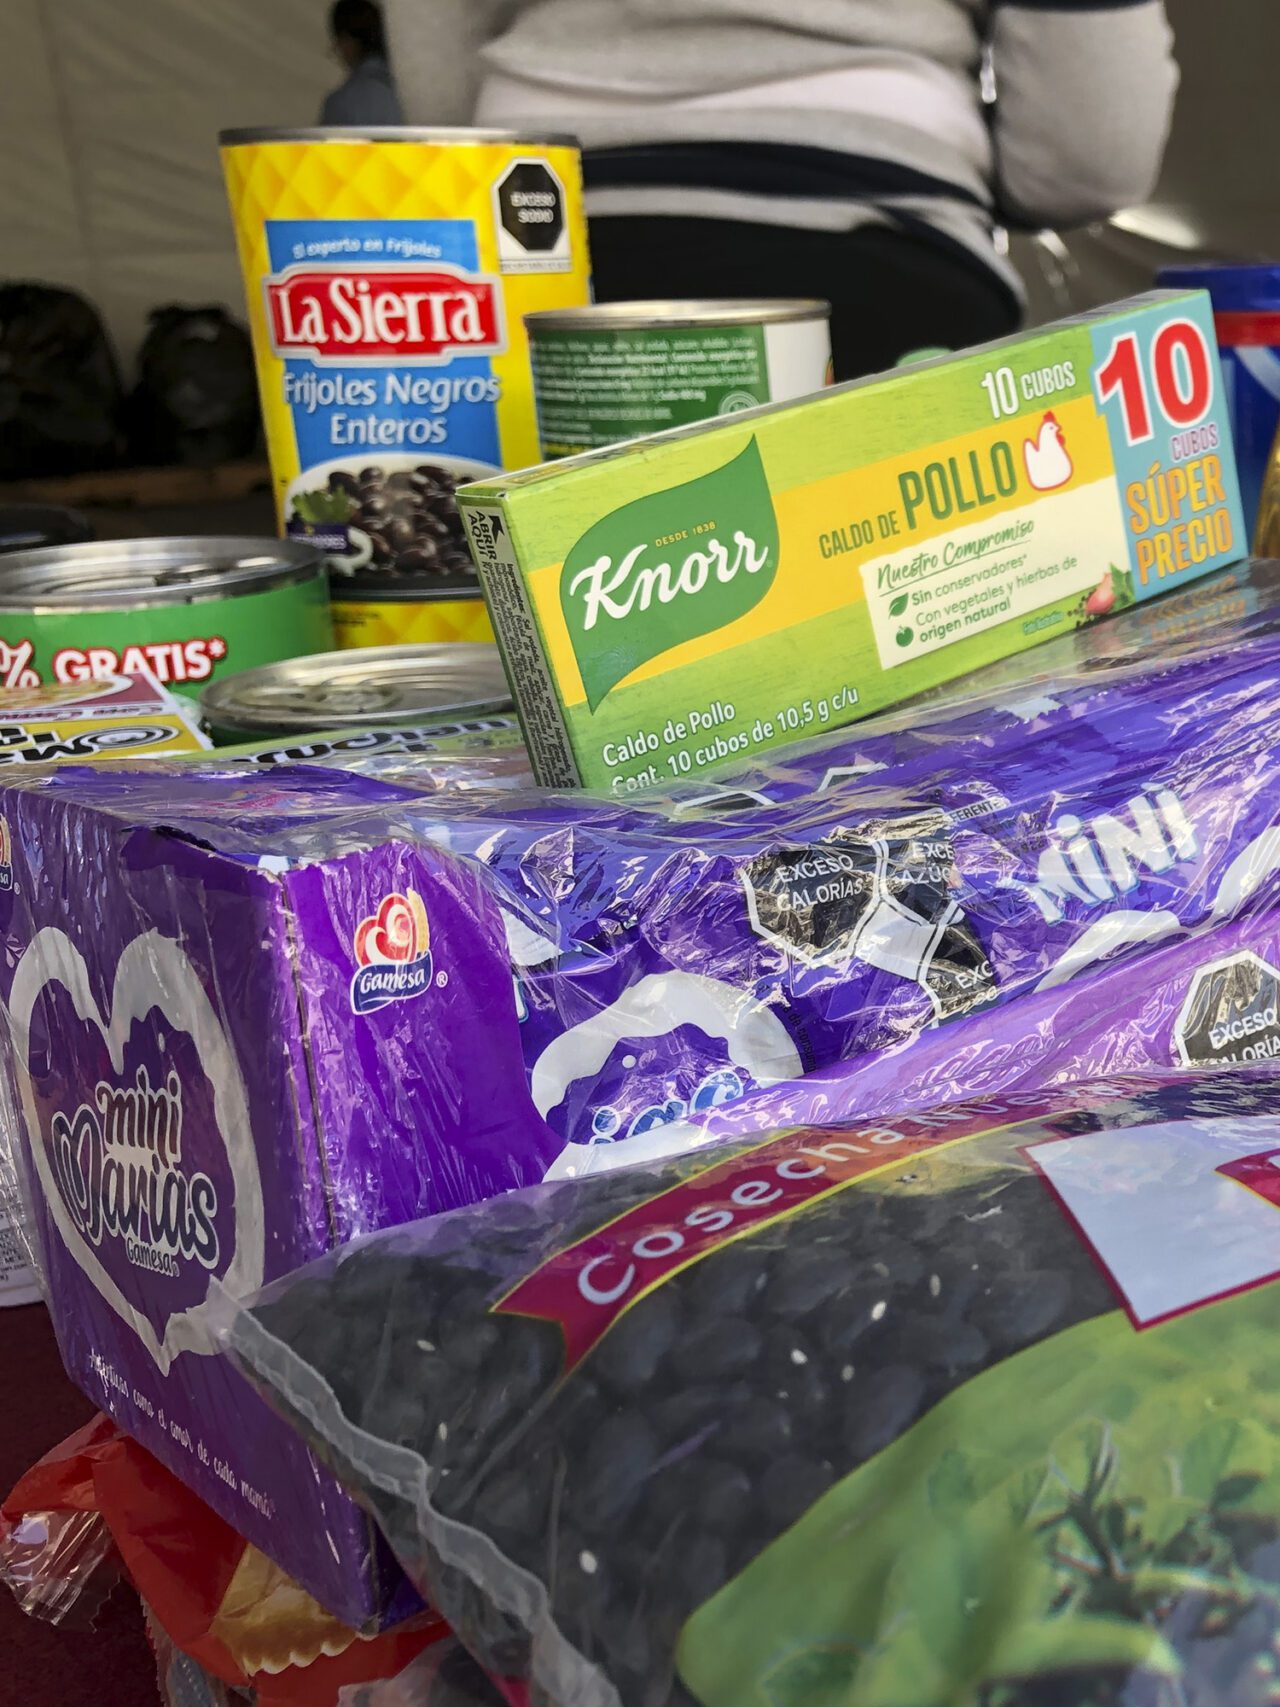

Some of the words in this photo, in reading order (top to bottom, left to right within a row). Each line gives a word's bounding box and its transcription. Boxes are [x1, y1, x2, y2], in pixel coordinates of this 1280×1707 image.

[276, 289, 328, 343] La
[329, 277, 485, 343] Sierra
[284, 372, 377, 413] Frijoles
[384, 373, 502, 414] Negros
[981, 366, 1020, 420] 10
[1020, 360, 1076, 401] CUBOS
[1094, 317, 1214, 448] 10
[330, 412, 448, 445] Enteros
[1171, 423, 1219, 463] CUBOS
[818, 518, 875, 560] CALDO
[876, 509, 900, 541] DE
[897, 440, 1018, 530] POLLO
[1126, 453, 1228, 535] SÚPER
[467, 513, 488, 557] AQUÍ
[476, 510, 498, 561] ABRIR
[654, 529, 689, 548] DESDE
[691, 521, 717, 537] 1838
[877, 549, 939, 591] Nuestro
[943, 519, 1035, 569] Compromiso
[1136, 506, 1234, 588] PRECIO
[569, 529, 769, 631] Knorr
[910, 590, 933, 607] Sin
[915, 611, 940, 628] Con
[940, 585, 1007, 623] vegetales
[1006, 582, 1014, 596] y
[1014, 567, 1060, 594] hierbas
[1061, 555, 1079, 572] de
[919, 617, 963, 645] origen
[963, 596, 1012, 631] natural
[602, 732, 660, 768] Caldo
[662, 720, 688, 745] de
[688, 700, 737, 738] Pollo
[611, 765, 666, 797] Cont.
[667, 748, 692, 777] 10
[695, 726, 750, 770] cubos
[751, 716, 774, 742] de
[775, 704, 815, 733] 10,5
[818, 700, 831, 720] g
[831, 687, 859, 713] c/u
[776, 877, 865, 912] CALORÍAS
[777, 854, 855, 884] EXCESO
[359, 967, 426, 995] Gamesa
[1208, 1007, 1278, 1049] EXCESO
[97, 1065, 181, 1169] mini
[578, 1128, 905, 1304] Cosecha
[127, 1237, 173, 1276] Gamesa
